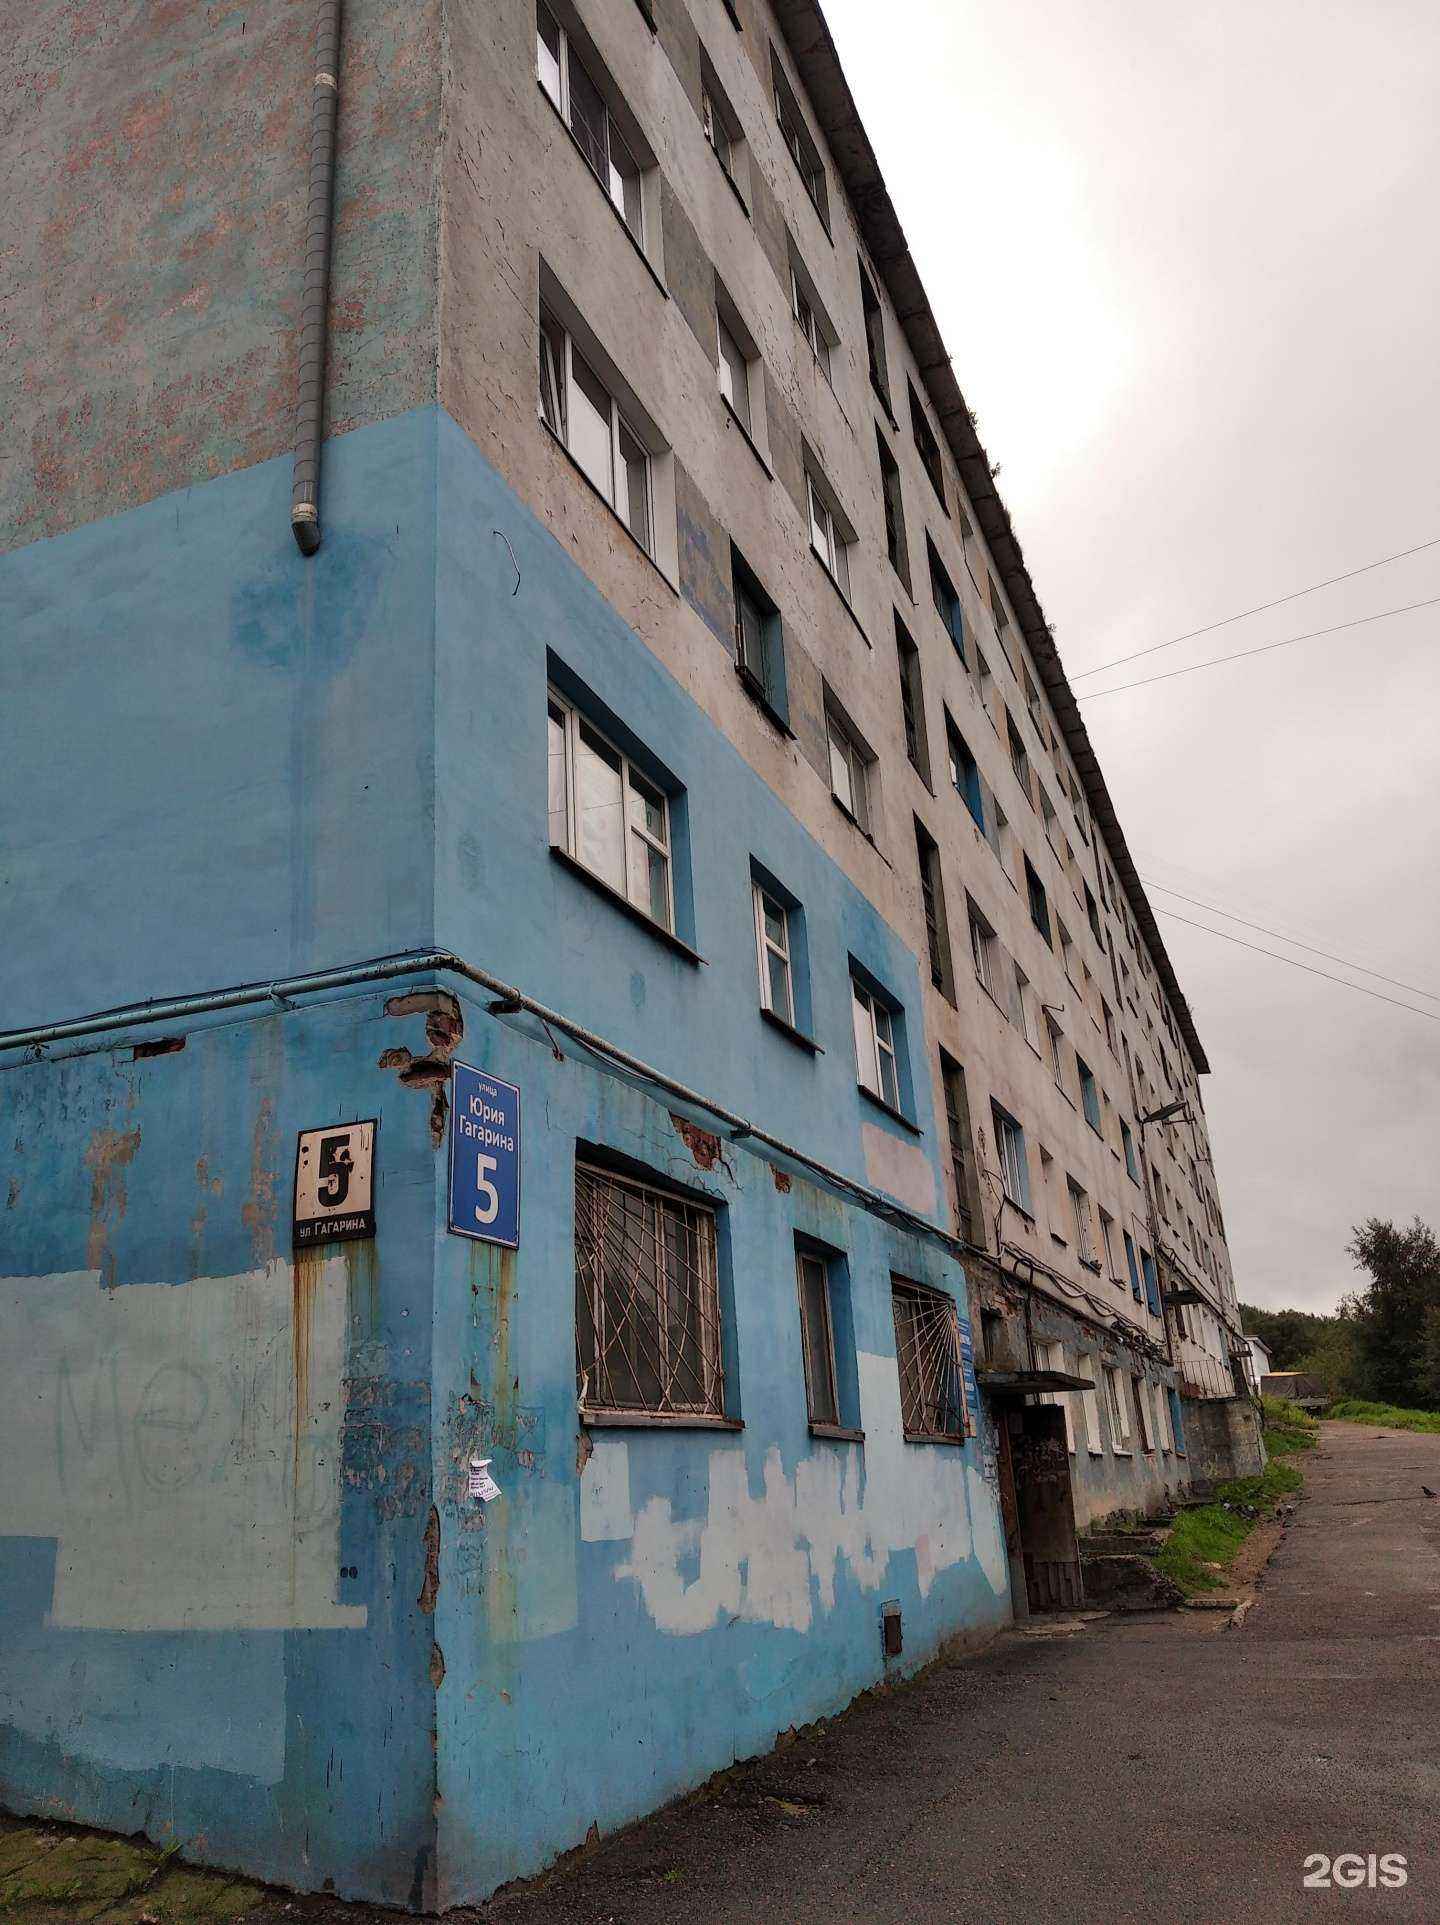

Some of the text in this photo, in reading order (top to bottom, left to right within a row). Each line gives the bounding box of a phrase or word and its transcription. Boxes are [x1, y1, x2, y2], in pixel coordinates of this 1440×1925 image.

[478, 1081, 498, 1097] улица
[469, 1094, 505, 1126] Юрия
[459, 1115, 514, 1152] Гагарина
[317, 1133, 354, 1207] 5
[475, 1153, 500, 1224] 5
